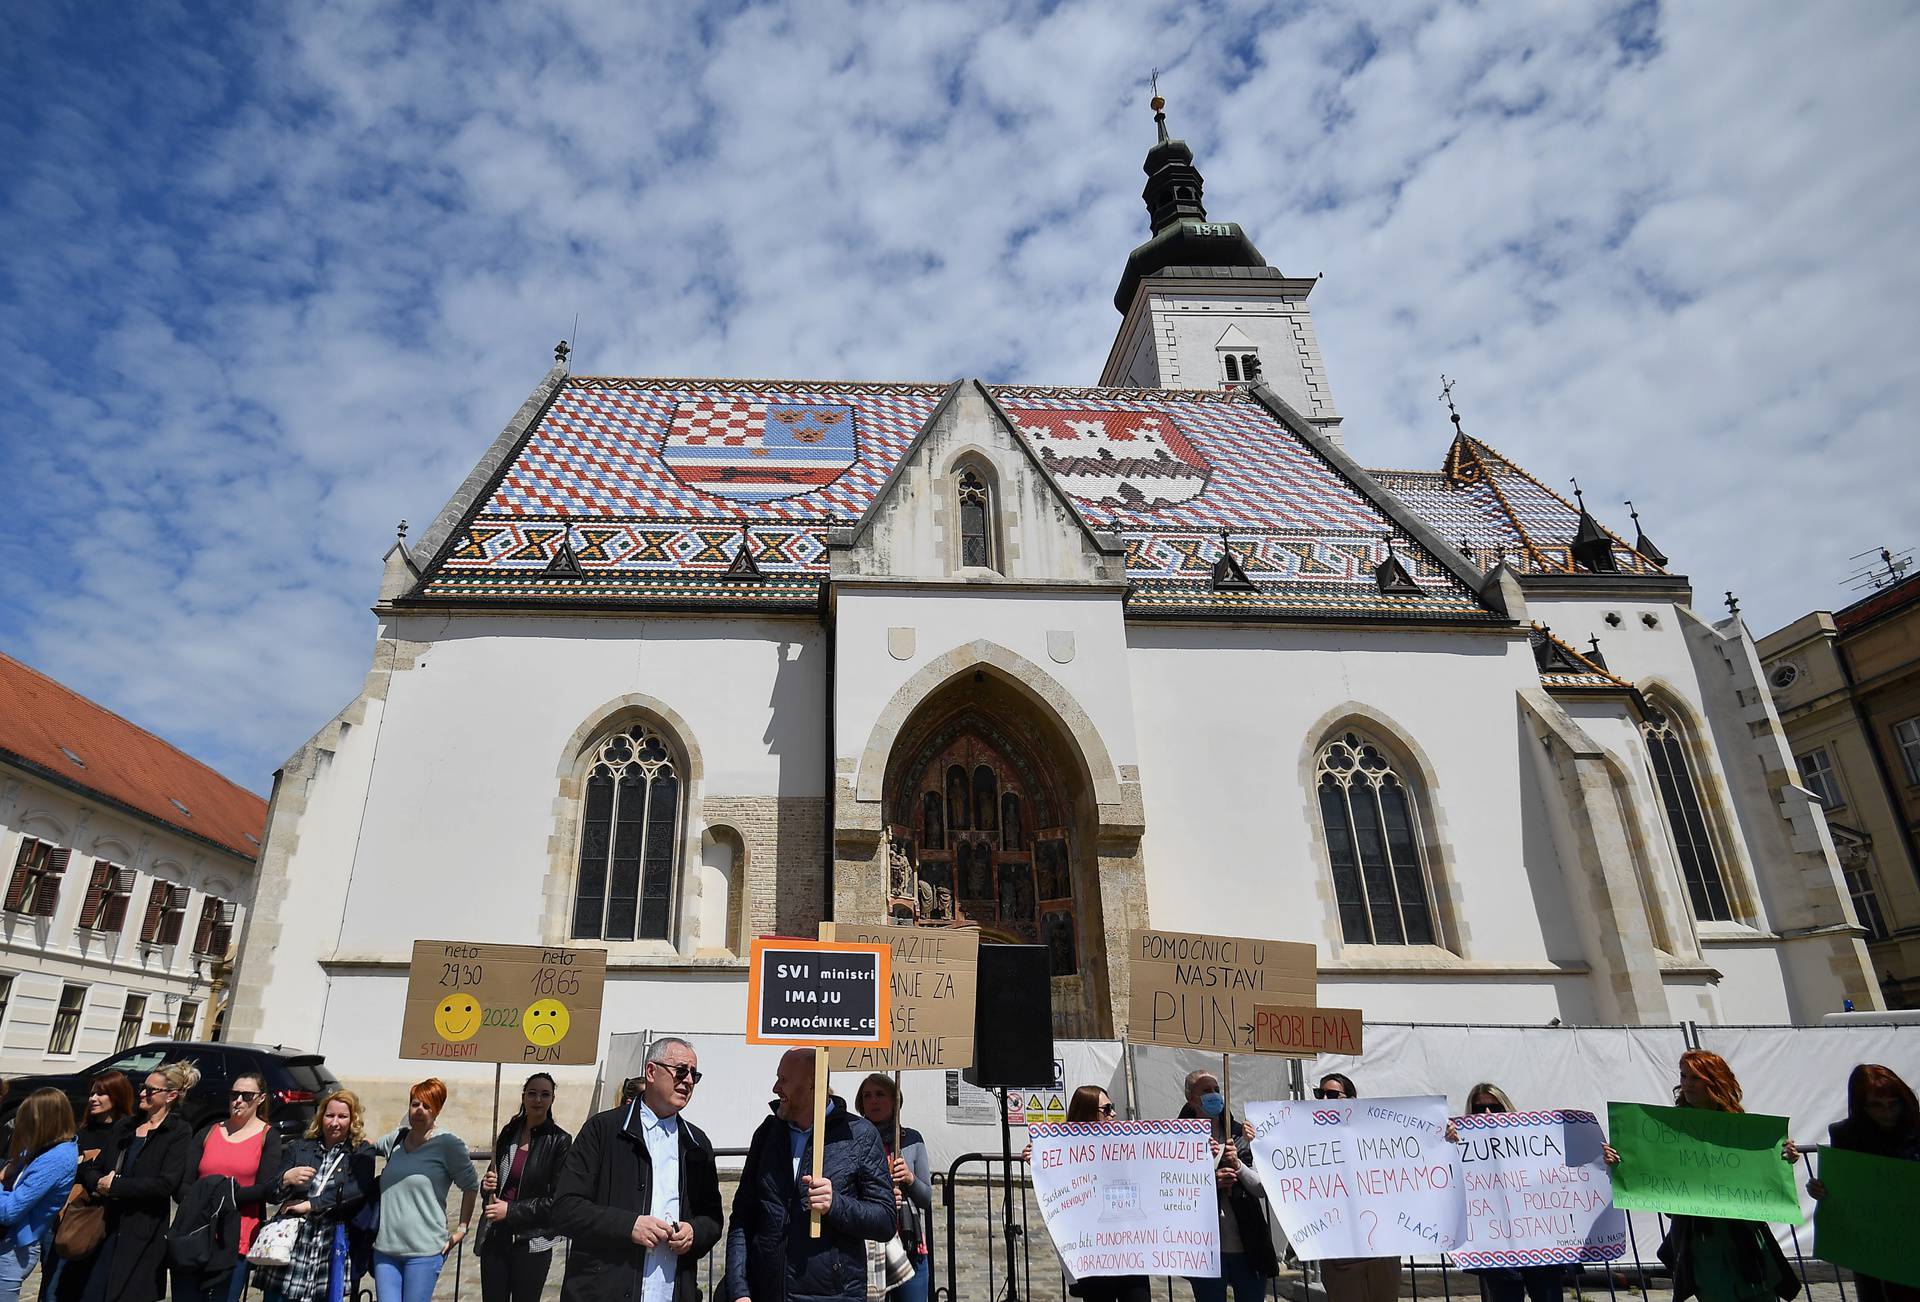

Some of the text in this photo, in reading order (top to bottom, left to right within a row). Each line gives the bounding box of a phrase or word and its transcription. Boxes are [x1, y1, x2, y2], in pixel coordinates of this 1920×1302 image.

[1194, 224, 1231, 237] 1841
[445, 945, 482, 959] neto
[542, 950, 576, 965] neto
[1142, 935, 1265, 965] POMOĆNICI U
[777, 964, 875, 980] SVI ministri
[1176, 963, 1264, 991] NASTAVI
[932, 972, 955, 999] ZA
[1153, 991, 1237, 1047] PUN
[1256, 1011, 1355, 1050] PROBLEMA
[420, 1043, 478, 1057] STUDENTI
[523, 1045, 561, 1061] PUN
[845, 1036, 946, 1068] ZANIMANJE
[1042, 1141, 1209, 1169] BEZ NAS NEMA INKLUZIJE!
[1271, 1135, 1426, 1171] OBVEZE IMAMO,
[1679, 1150, 1741, 1169] IMAMO
[1160, 1171, 1212, 1186] PRAVILNIK
[1280, 1164, 1456, 1203] PRAVA NEMAMO!
[1465, 1164, 1590, 1193] ŠAVANJE NAŠEG
[1641, 1174, 1690, 1197] PRAVA
[1159, 1187, 1201, 1199] nas NIJE
[1504, 1195, 1511, 1213] I
[1523, 1186, 1606, 1212] POLOŽAJA
[1096, 1229, 1158, 1247] PUNOPRAVNI
[1163, 1227, 1213, 1247] ČLANOVI
[1488, 1213, 1576, 1240] SUSTAVU!
[1598, 1234, 1604, 1244] U
[1152, 1250, 1215, 1271] SUSTAVA!
